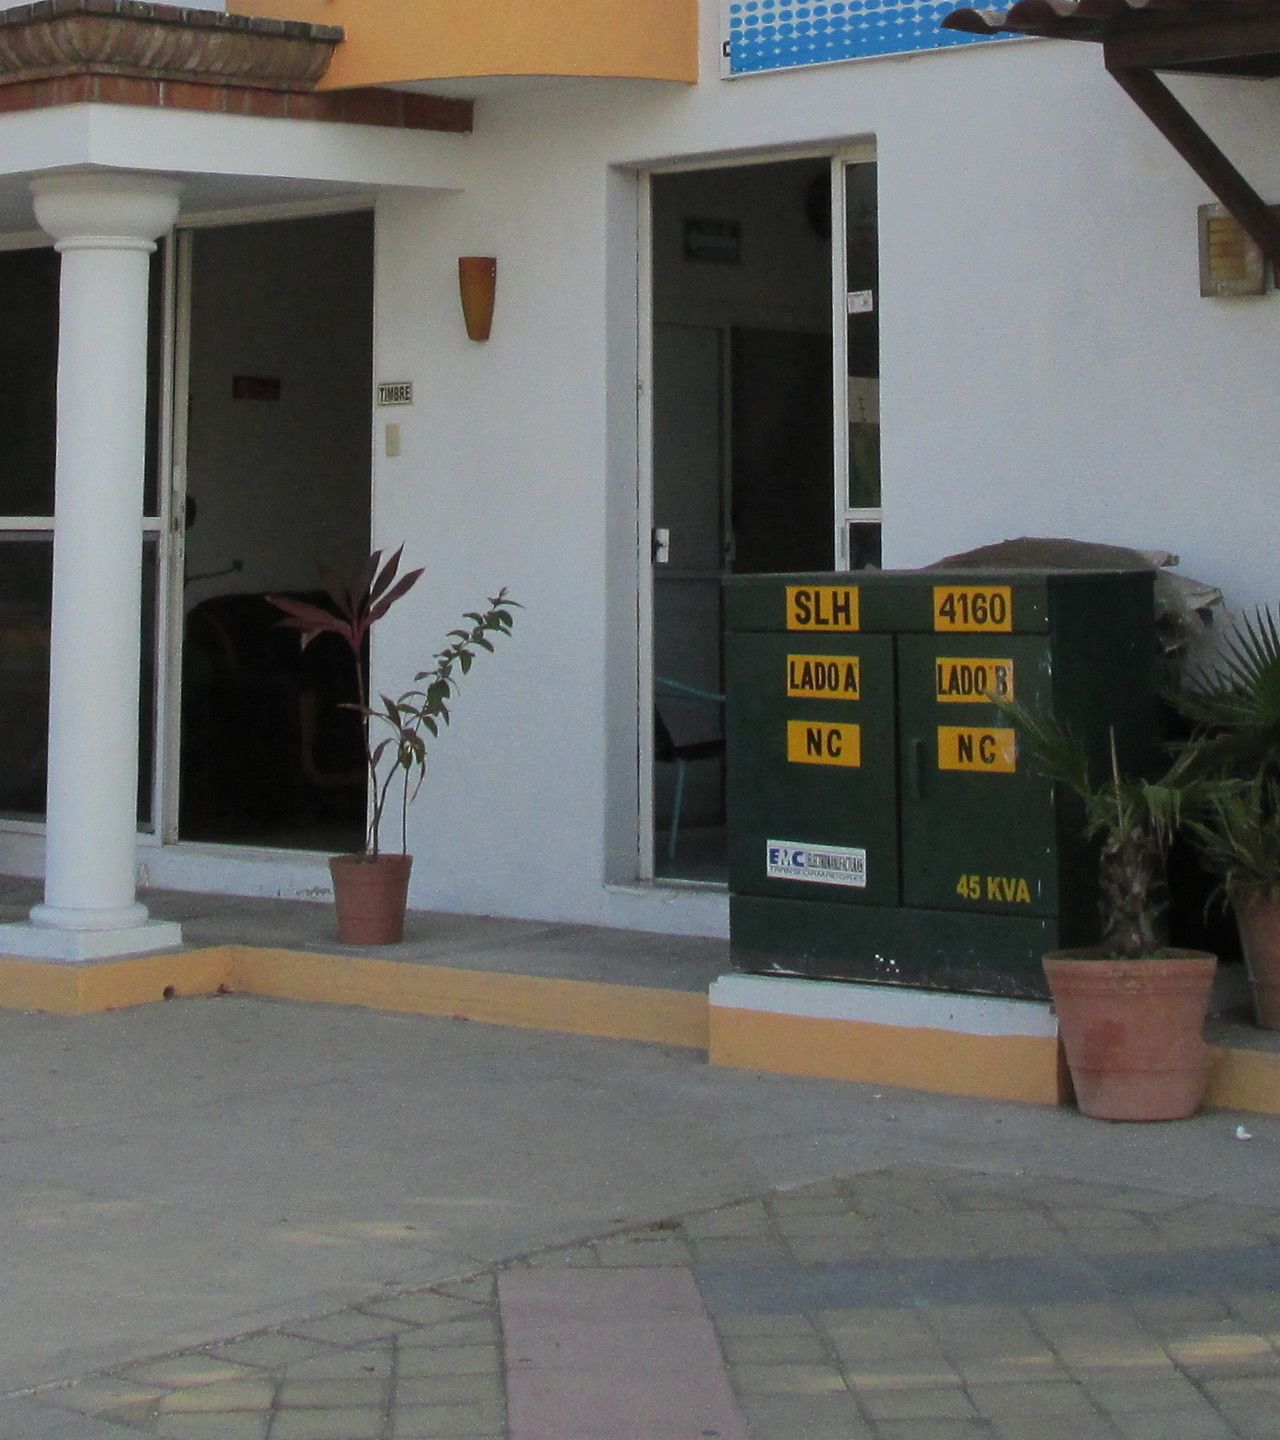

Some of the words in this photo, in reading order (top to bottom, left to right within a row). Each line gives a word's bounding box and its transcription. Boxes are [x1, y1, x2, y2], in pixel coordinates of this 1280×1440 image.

[379, 386, 411, 403] TIMBRE
[793, 589, 852, 626] SLH
[938, 592, 1007, 625] 4160
[789, 662, 840, 693] LADO
[843, 663, 858, 693] A
[936, 663, 988, 696] LADO
[805, 727, 843, 758] NC
[956, 874, 981, 900] 45
[987, 875, 1031, 904] KVA
